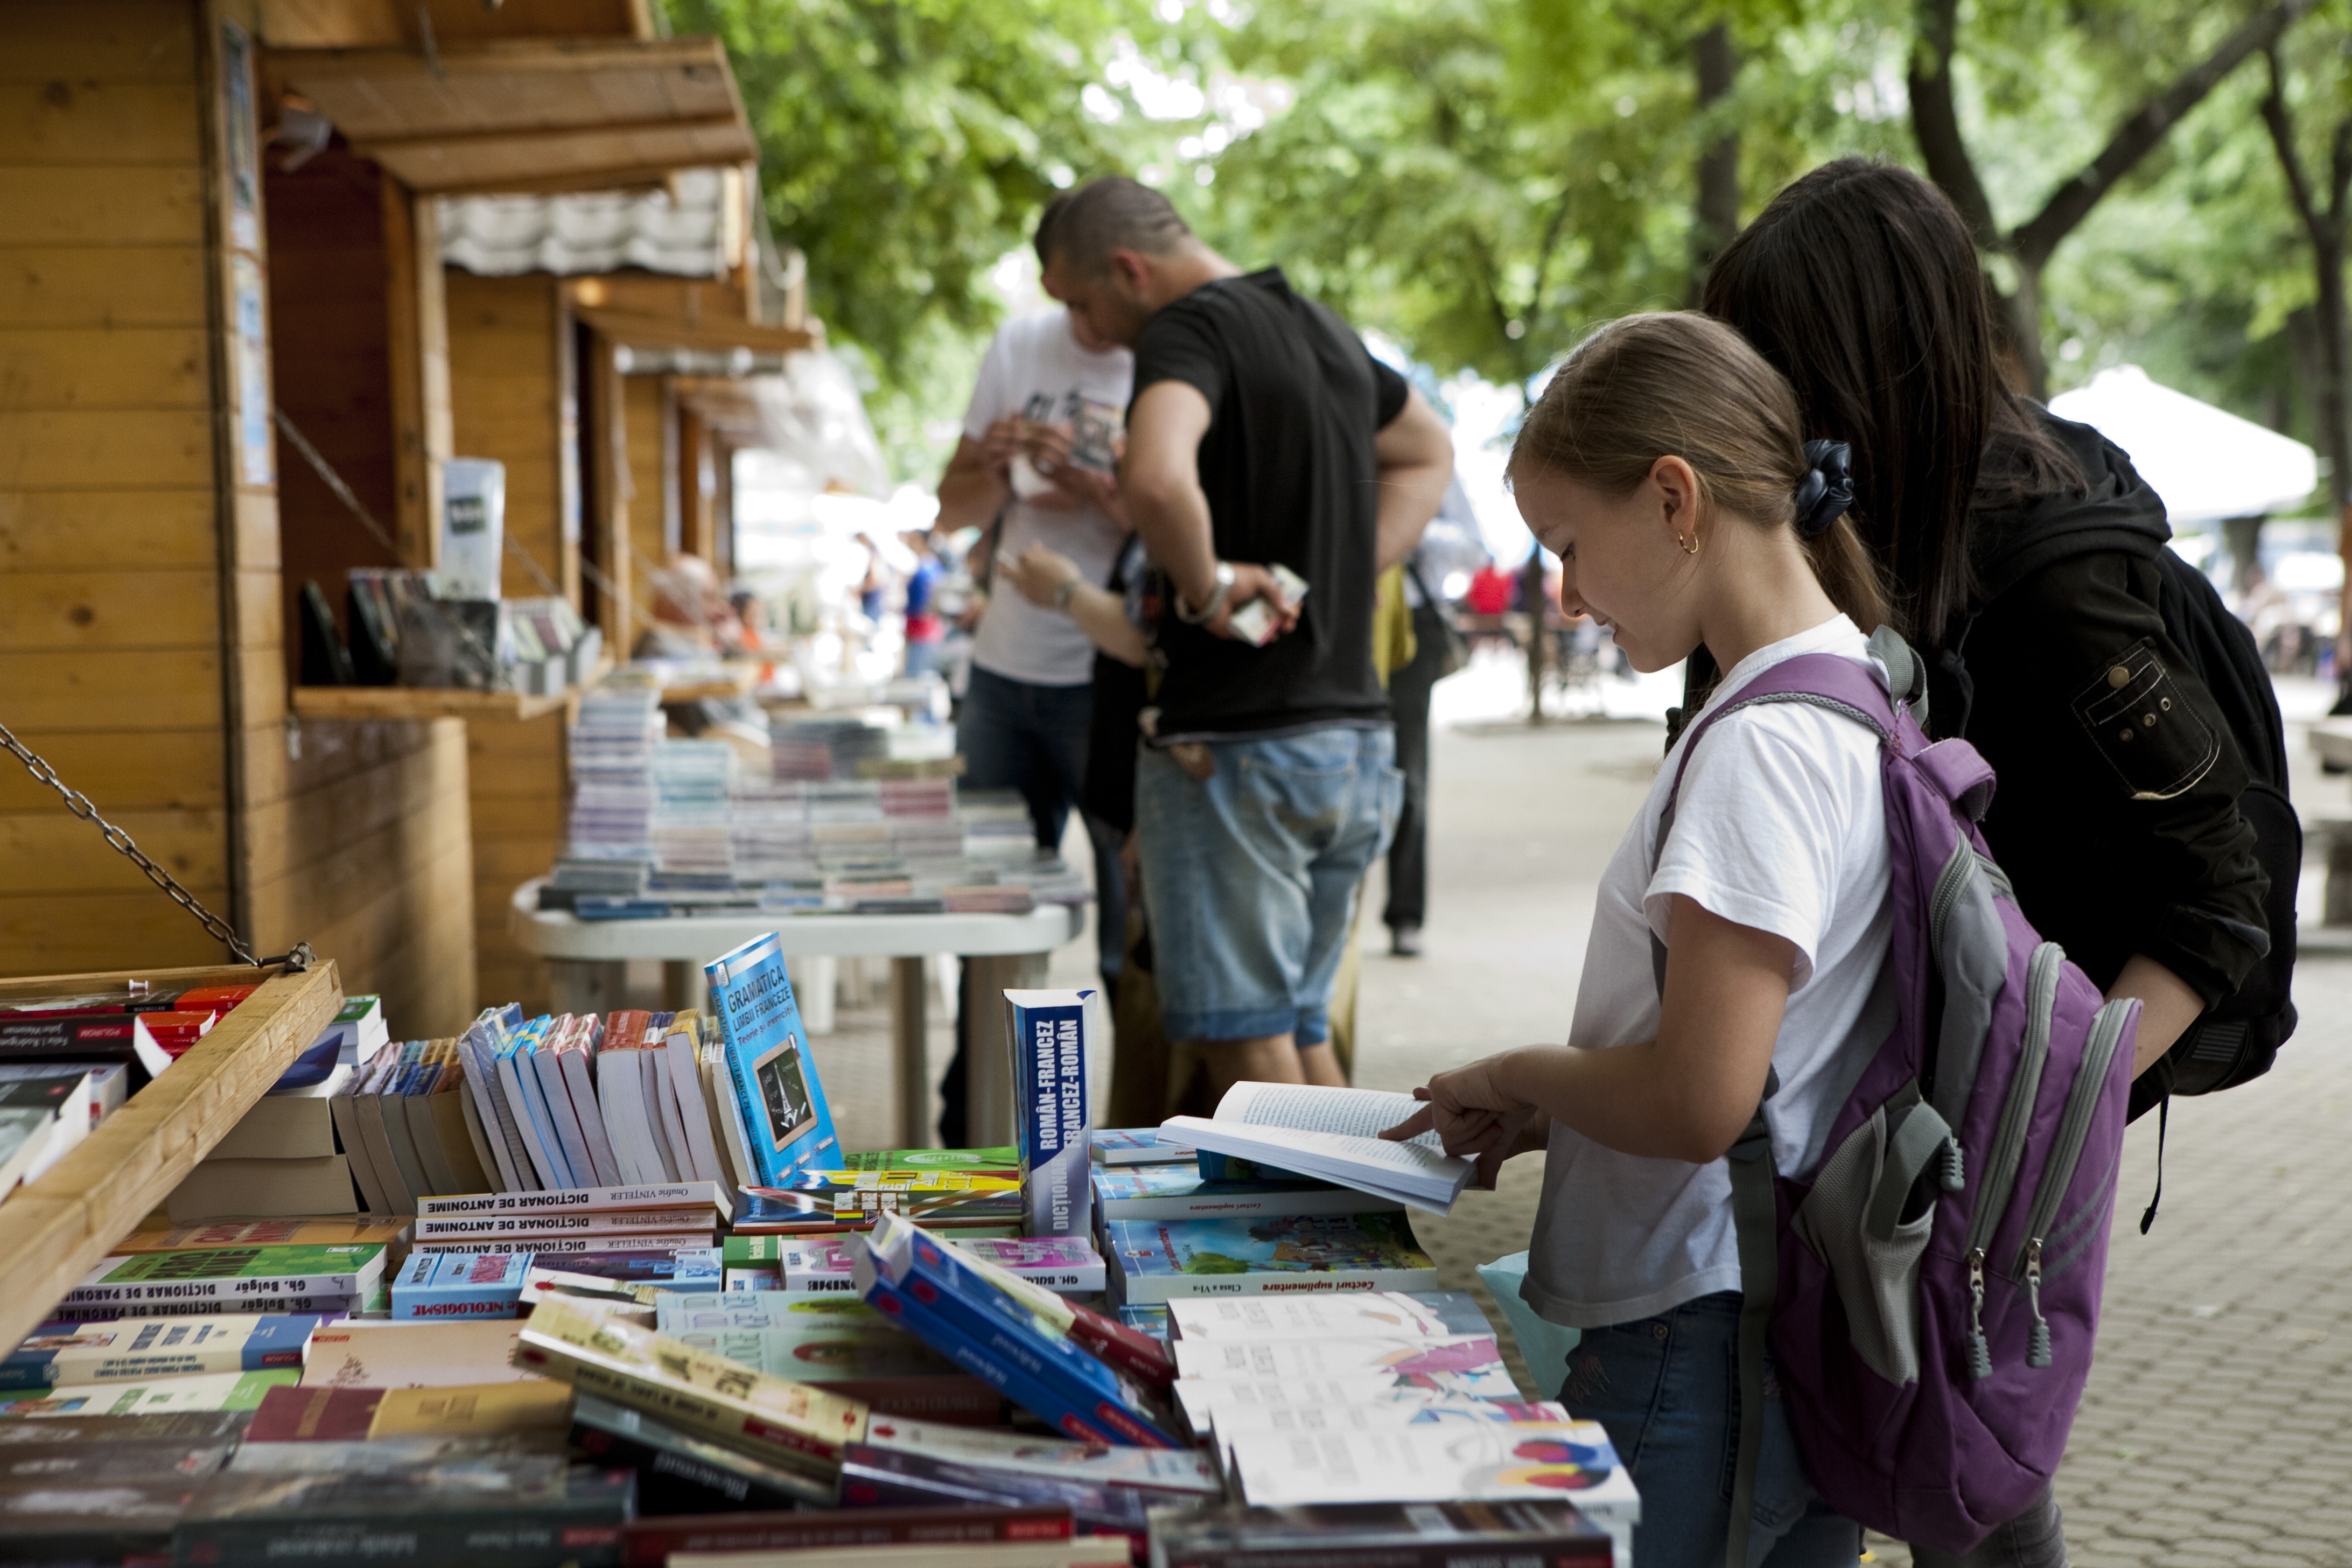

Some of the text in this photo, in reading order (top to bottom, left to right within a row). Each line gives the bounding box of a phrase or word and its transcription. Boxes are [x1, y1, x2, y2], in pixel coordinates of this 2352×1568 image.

[729, 965, 785, 1013] GRAMATICA
[733, 987, 790, 1032] LIMBII FRANCEZE
[737, 1005, 795, 1046] Teorie și exerciții
[713, 992, 731, 1040] GRAMATICA
[726, 1041, 738, 1068] LIMBII
[736, 1069, 751, 1111] FRANCEZE
[1035, 1020, 1058, 1150] ROMÂN-FRANCEZ
[1057, 1019, 1082, 1149] FRANCEZ-ROMÂN
[428, 1192, 589, 1213] DICȚIONAR DE ANTONIME
[610, 1187, 689, 1201] Onufrie VINȚELER
[1051, 1158, 1072, 1230] DICȚIONAR
[425, 1217, 589, 1233] DICȚIONAR DE ANTONIME
[611, 1214, 689, 1226] Onufrie VINȚELER
[422, 1238, 586, 1255] DICȚIONAR DE ANTONIME
[607, 1237, 686, 1249] Onufrie VINȚELER
[1023, 1275, 1078, 1285] GH. BULG
[1193, 1284, 1210, 1292] VI-a
[1226, 1284, 1241, 1292] Clasa
[1262, 1280, 1333, 1292] suplimentare
[1336, 1280, 1375, 1290] Lecturi
[66, 1279, 306, 1304] Gh. Bulgăr DICȚIONAR DE PARONI
[57, 1297, 312, 1321] Gh. Bulgăr DICȚIONAR DE PARONIME
[411, 1301, 504, 1317] NEOLOGISME
